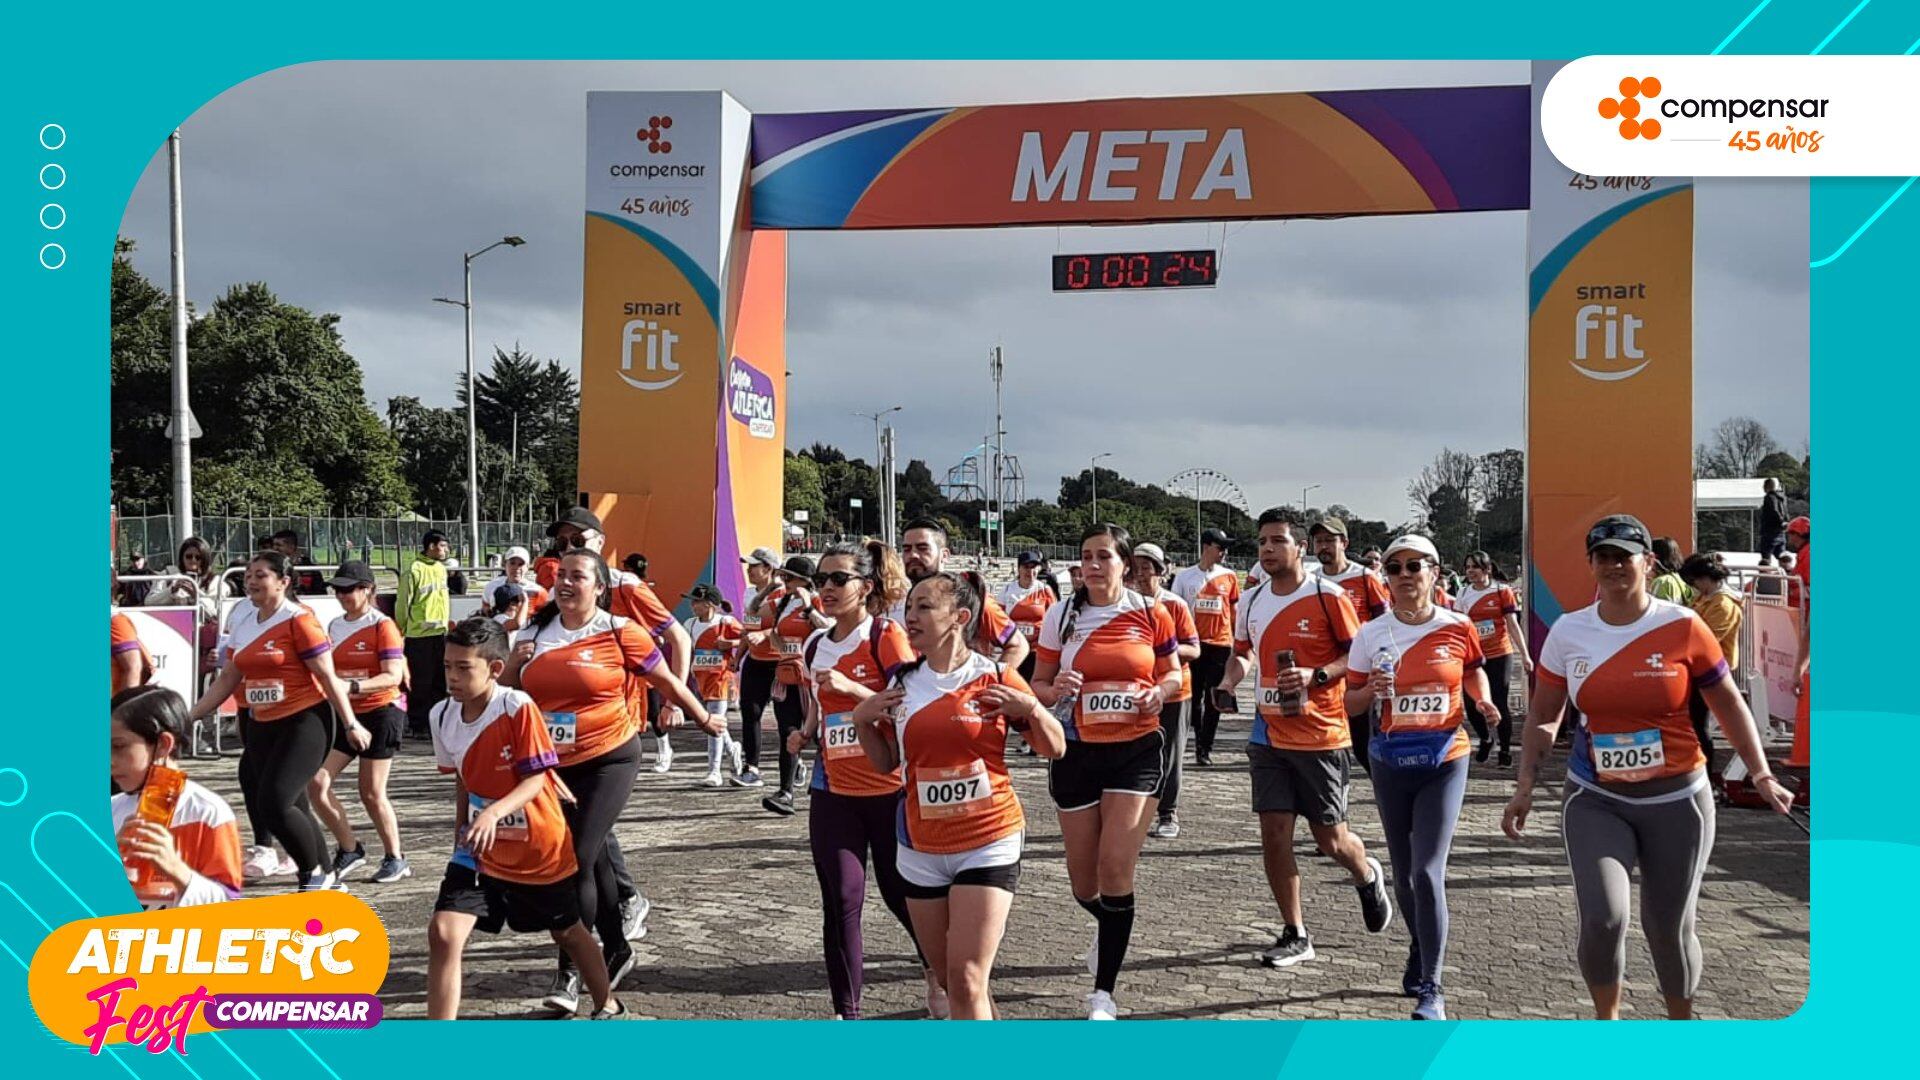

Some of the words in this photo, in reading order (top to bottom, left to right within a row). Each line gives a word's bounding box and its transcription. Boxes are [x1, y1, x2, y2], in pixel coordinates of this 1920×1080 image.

[610, 165, 705, 180] compensar
[1010, 128, 1253, 202] META
[620, 197, 645, 214] 45
[648, 195, 693, 217] años
[1576, 282, 1646, 300] smart
[623, 301, 682, 316] smart
[1575, 305, 1645, 360] fit
[622, 319, 680, 371] fit
[250, 689, 278, 701] 0018
[1090, 695, 1133, 711] 0065
[1399, 696, 1443, 713] 0132
[1601, 747, 1652, 769] 8205
[927, 778, 980, 804] 0097
